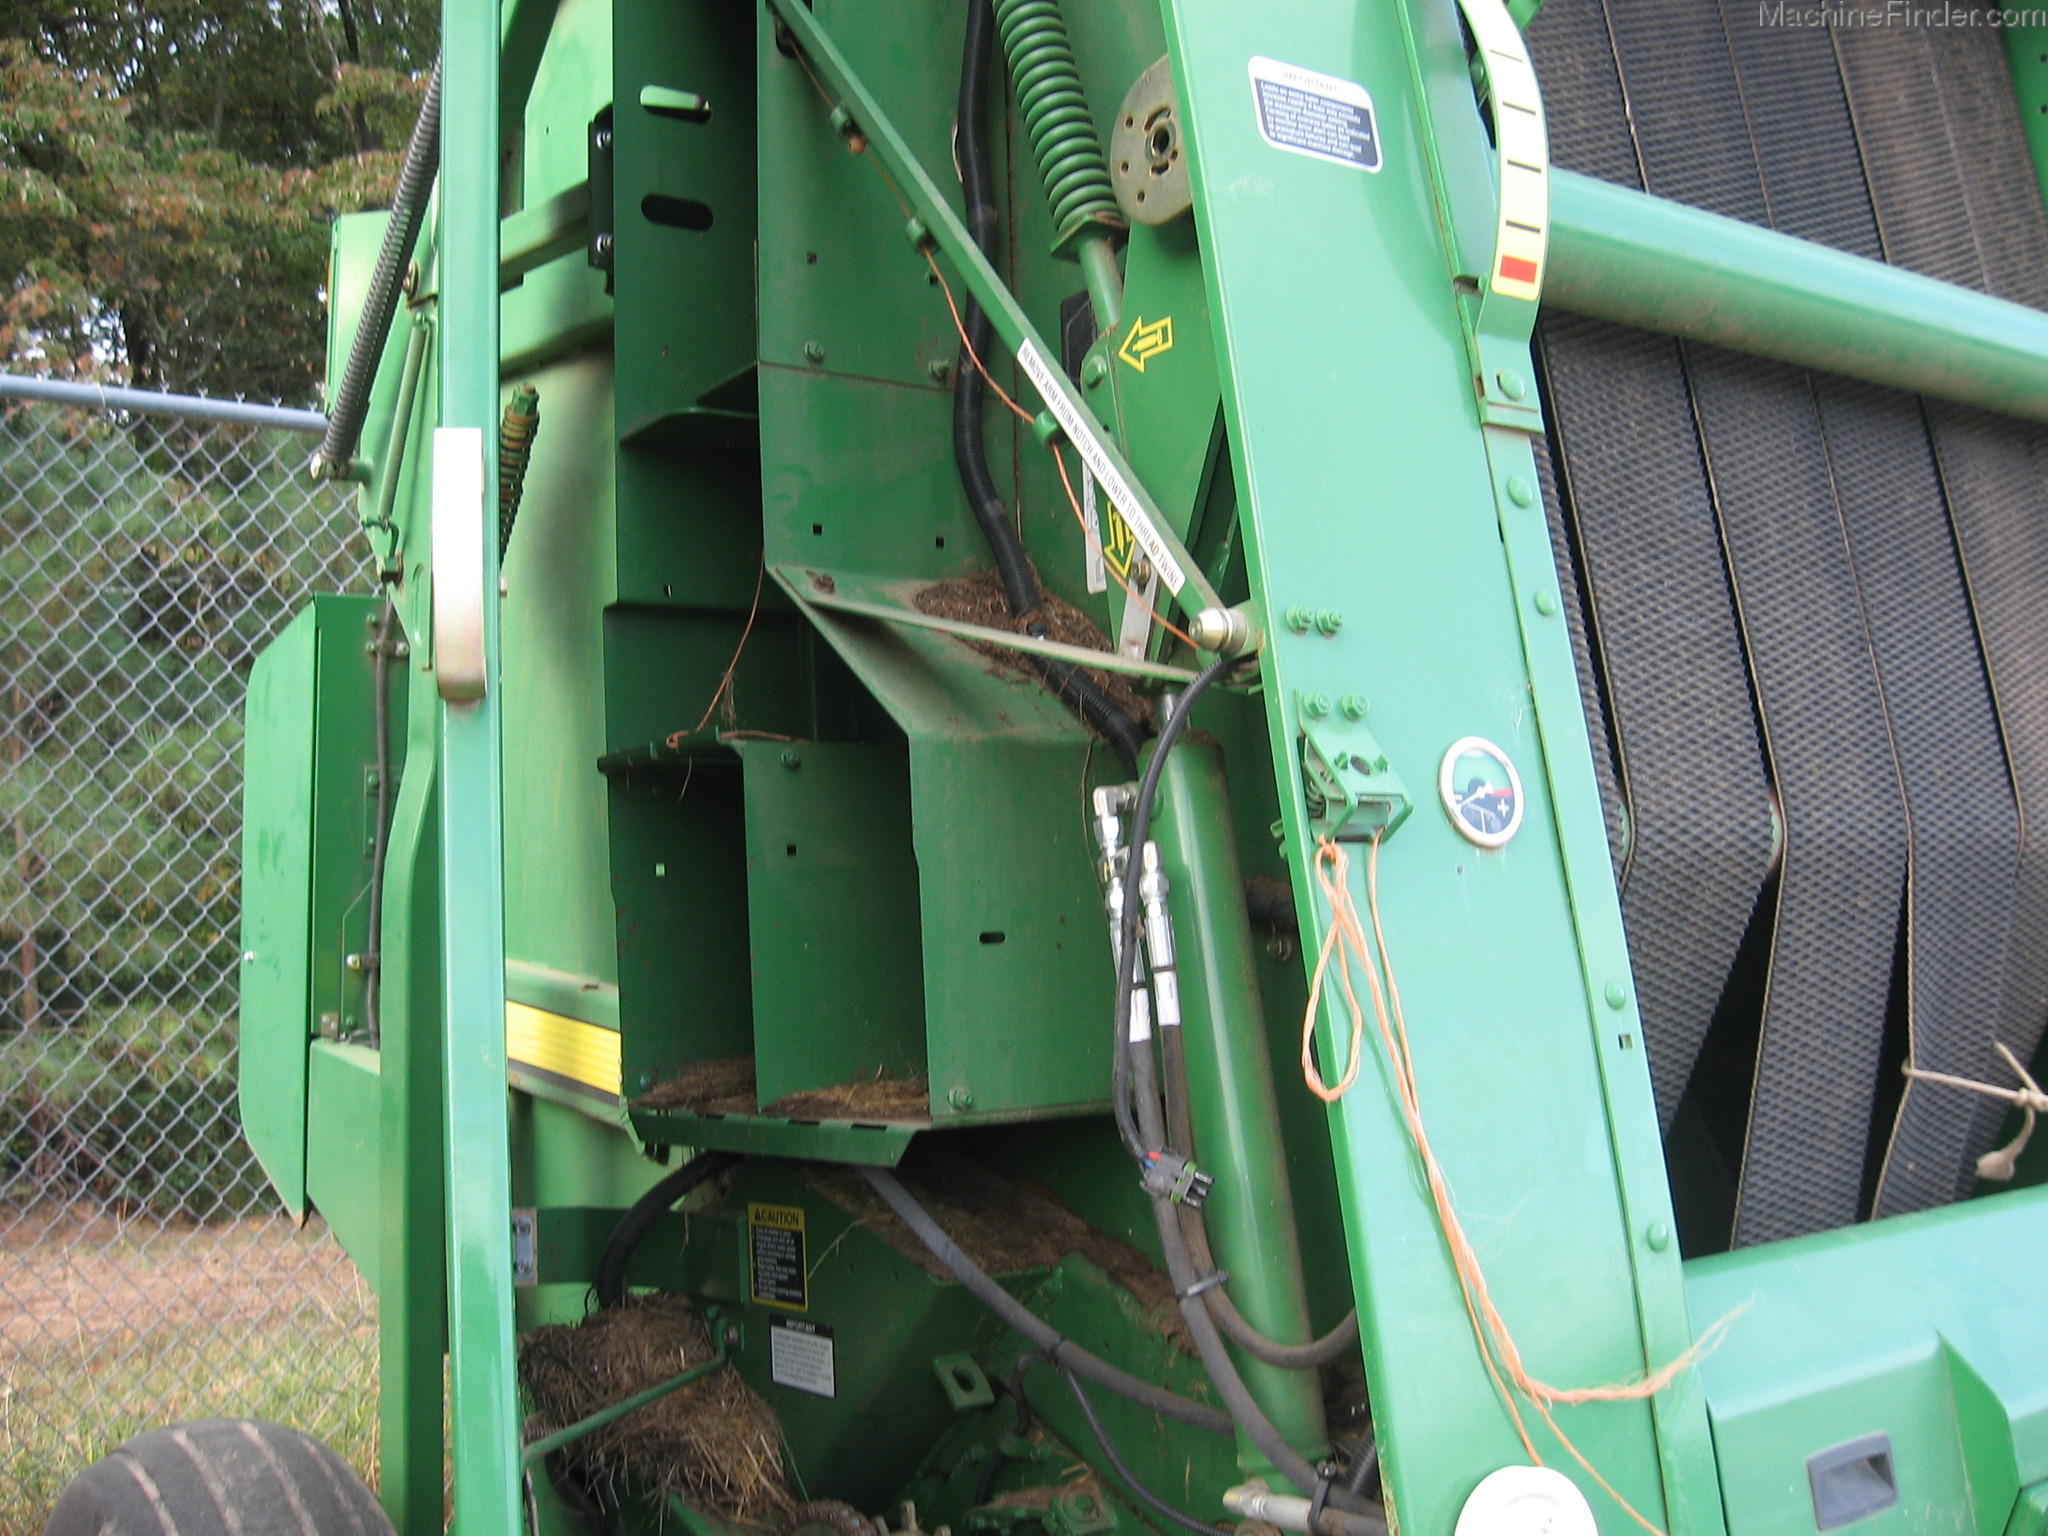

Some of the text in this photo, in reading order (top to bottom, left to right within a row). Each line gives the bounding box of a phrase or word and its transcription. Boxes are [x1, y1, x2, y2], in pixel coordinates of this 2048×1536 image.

[1020, 345, 1180, 590] REMOVE ARM FROM NOTCH AND LOWER TO THREAD TWINE
[761, 1209, 799, 1225] CAUTION
